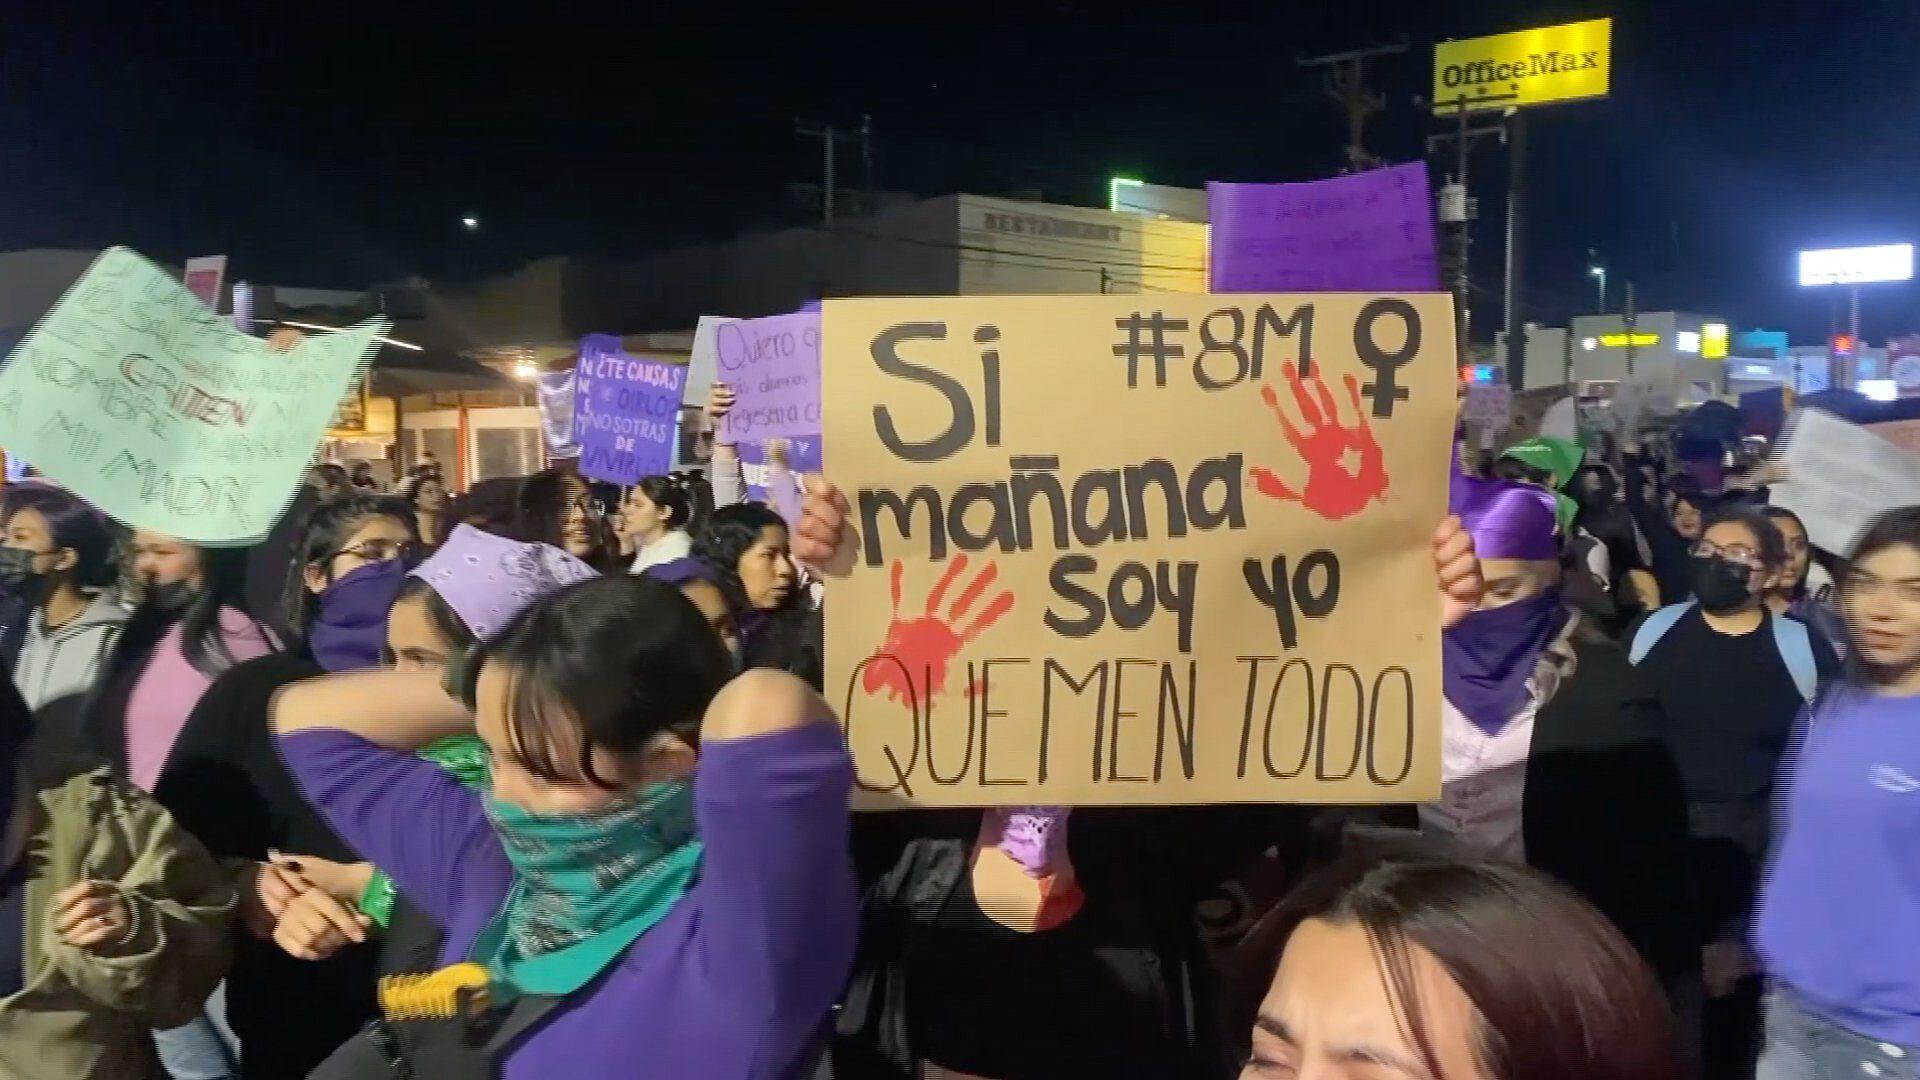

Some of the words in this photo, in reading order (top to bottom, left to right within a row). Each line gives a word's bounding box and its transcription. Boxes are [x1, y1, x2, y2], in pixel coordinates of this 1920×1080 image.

[1442, 50, 1598, 88] OfficeMax
[985, 212, 1122, 242] RESTAT
[717, 323, 796, 371] Quiero
[1112, 302, 1314, 391] #8M
[597, 353, 626, 380] ¿TE
[626, 361, 682, 392] CANSAS
[870, 322, 1001, 463] Si
[590, 411, 668, 445] NOSOTRAS
[614, 435, 637, 453] DE
[858, 452, 1246, 567] mañana
[1044, 554, 1198, 653] soy
[1243, 548, 1340, 650] yo
[845, 652, 1197, 797] QUEMEN
[1236, 655, 1413, 786] TODO
